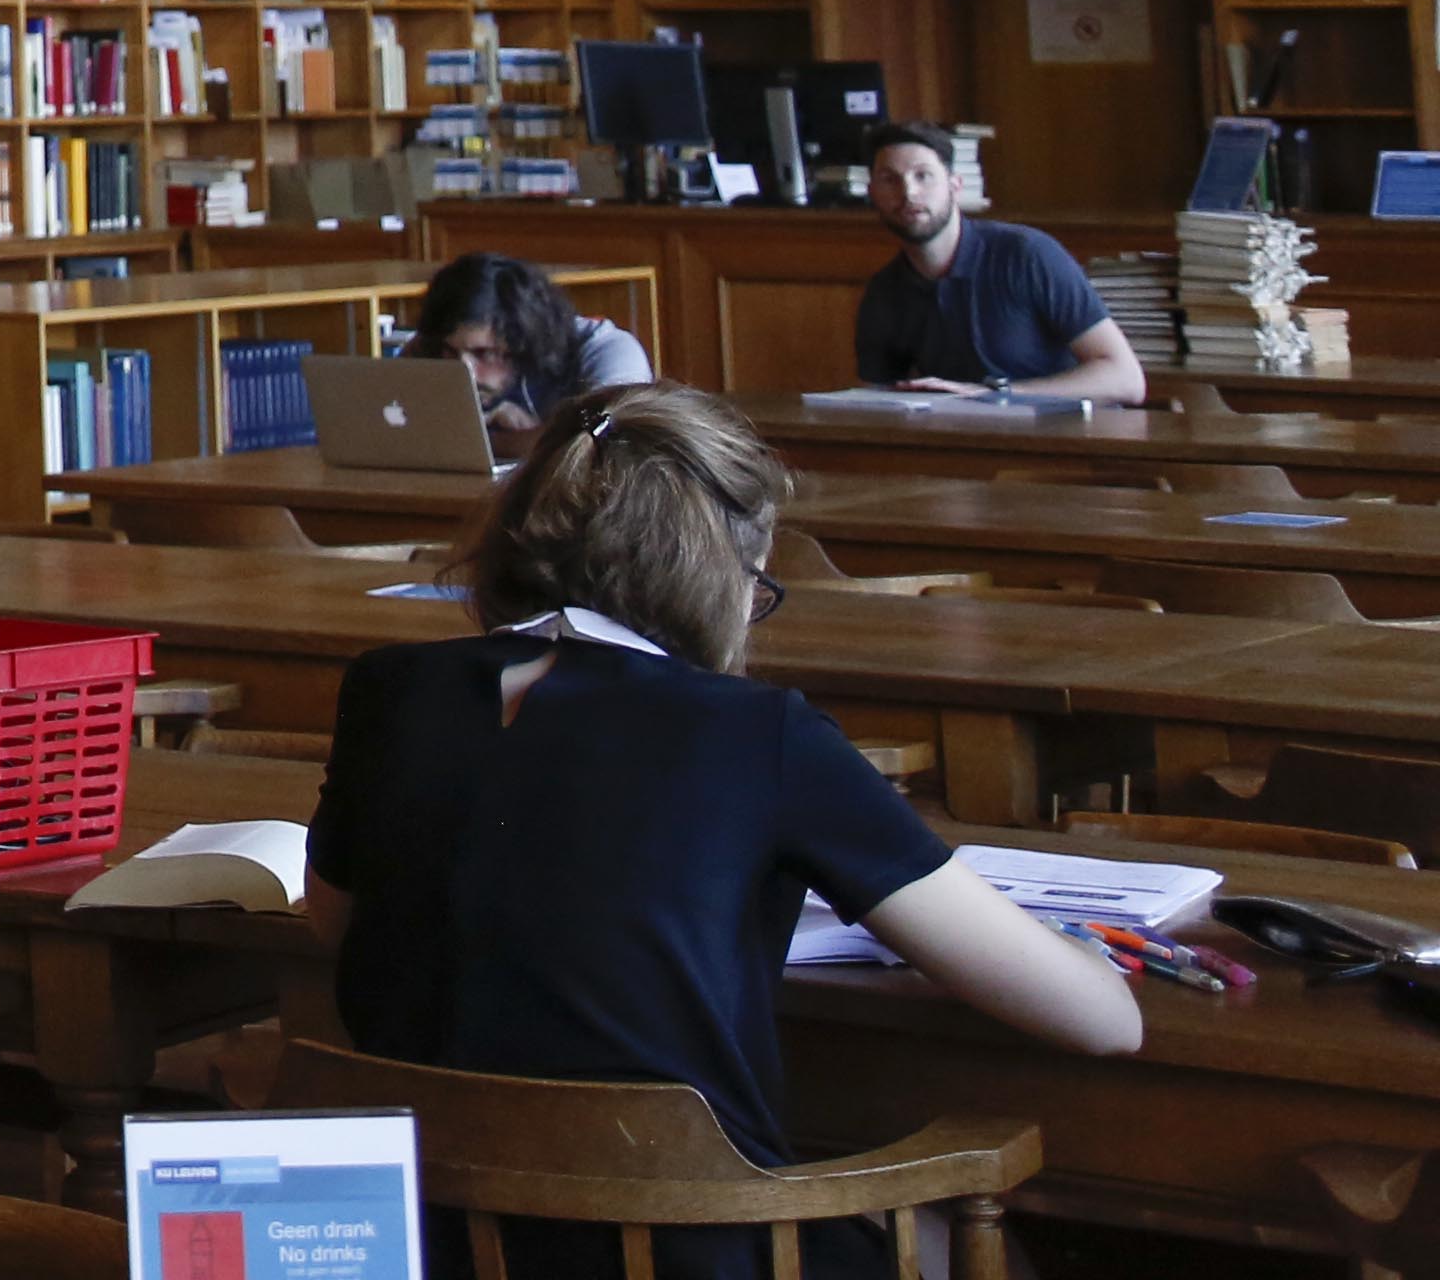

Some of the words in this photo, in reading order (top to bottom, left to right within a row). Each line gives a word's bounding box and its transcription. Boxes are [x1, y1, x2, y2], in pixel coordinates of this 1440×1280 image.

[155, 1168, 172, 1178] KU
[174, 1167, 218, 1178] LEUVEN
[268, 1222, 318, 1239] Geen
[324, 1220, 375, 1238] drank
[280, 1246, 305, 1262] No
[311, 1244, 366, 1262] drinks
